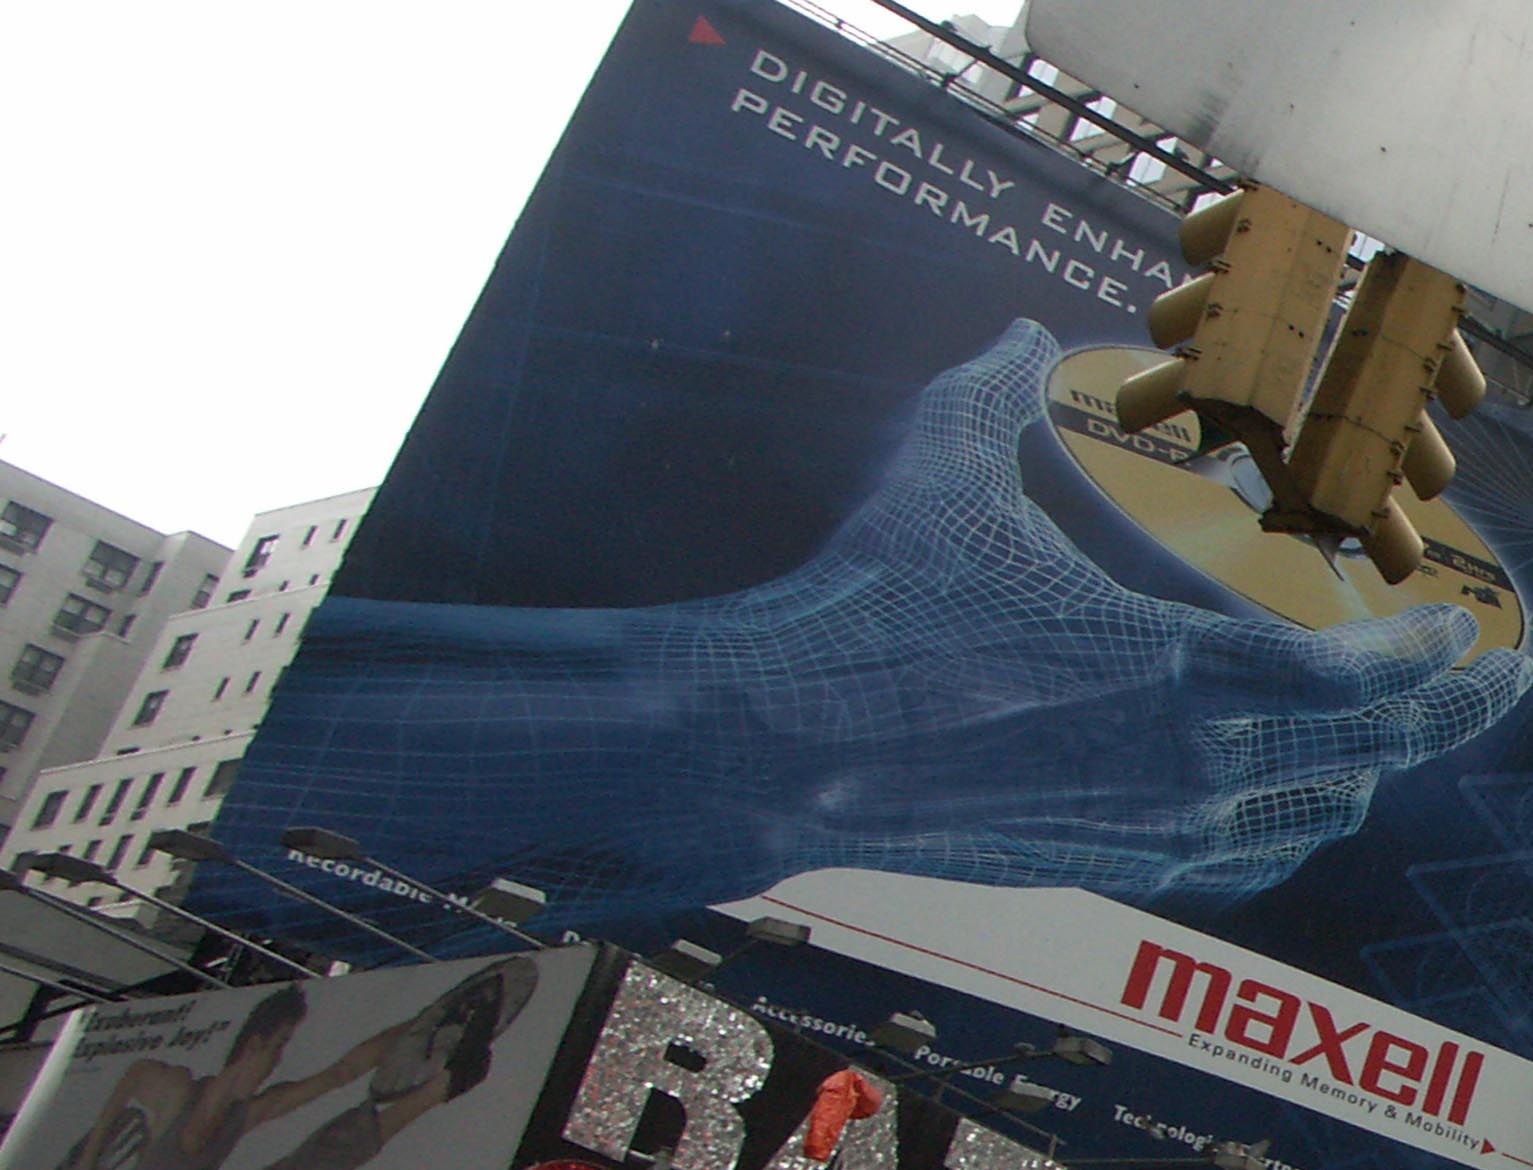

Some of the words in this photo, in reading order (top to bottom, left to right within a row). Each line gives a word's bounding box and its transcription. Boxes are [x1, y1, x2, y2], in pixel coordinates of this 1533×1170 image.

[731, 88, 1138, 314] PERFORMANCE.
[1120, 938, 1485, 1127] maxell
[1189, 1032, 1294, 1083] Expanding
[1300, 1073, 1378, 1117] Memory
[1383, 1102, 1401, 1119] &
[1405, 1106, 1481, 1152] Mobility
